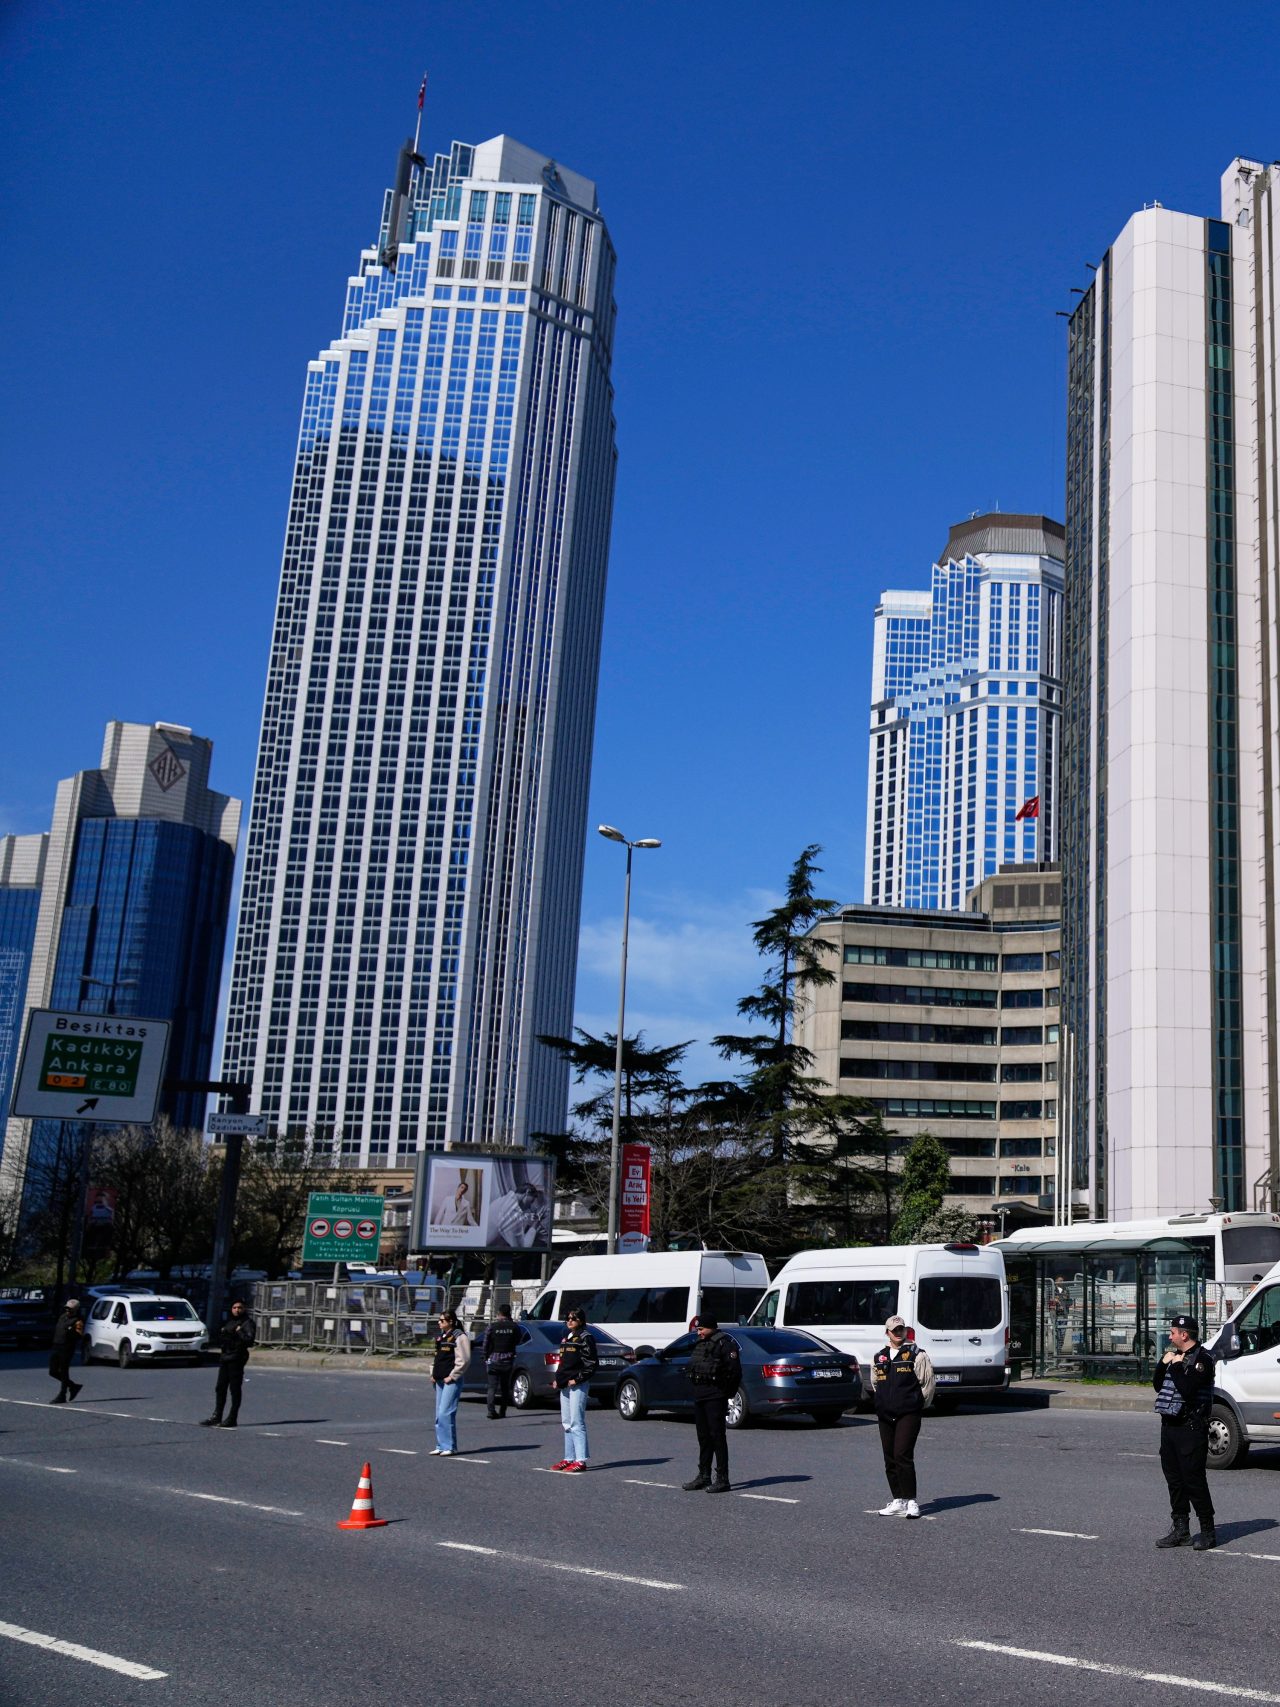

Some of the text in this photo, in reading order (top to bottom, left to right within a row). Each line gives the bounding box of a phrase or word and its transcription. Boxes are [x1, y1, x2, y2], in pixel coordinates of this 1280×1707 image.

[56, 1018, 147, 1038] Beşiktaş
[52, 1039, 137, 1060] Kadıköy
[49, 1057, 126, 1074] Ankara
[632, 1168, 640, 1176] Ev
[1015, 1164, 1030, 1172] Kale
